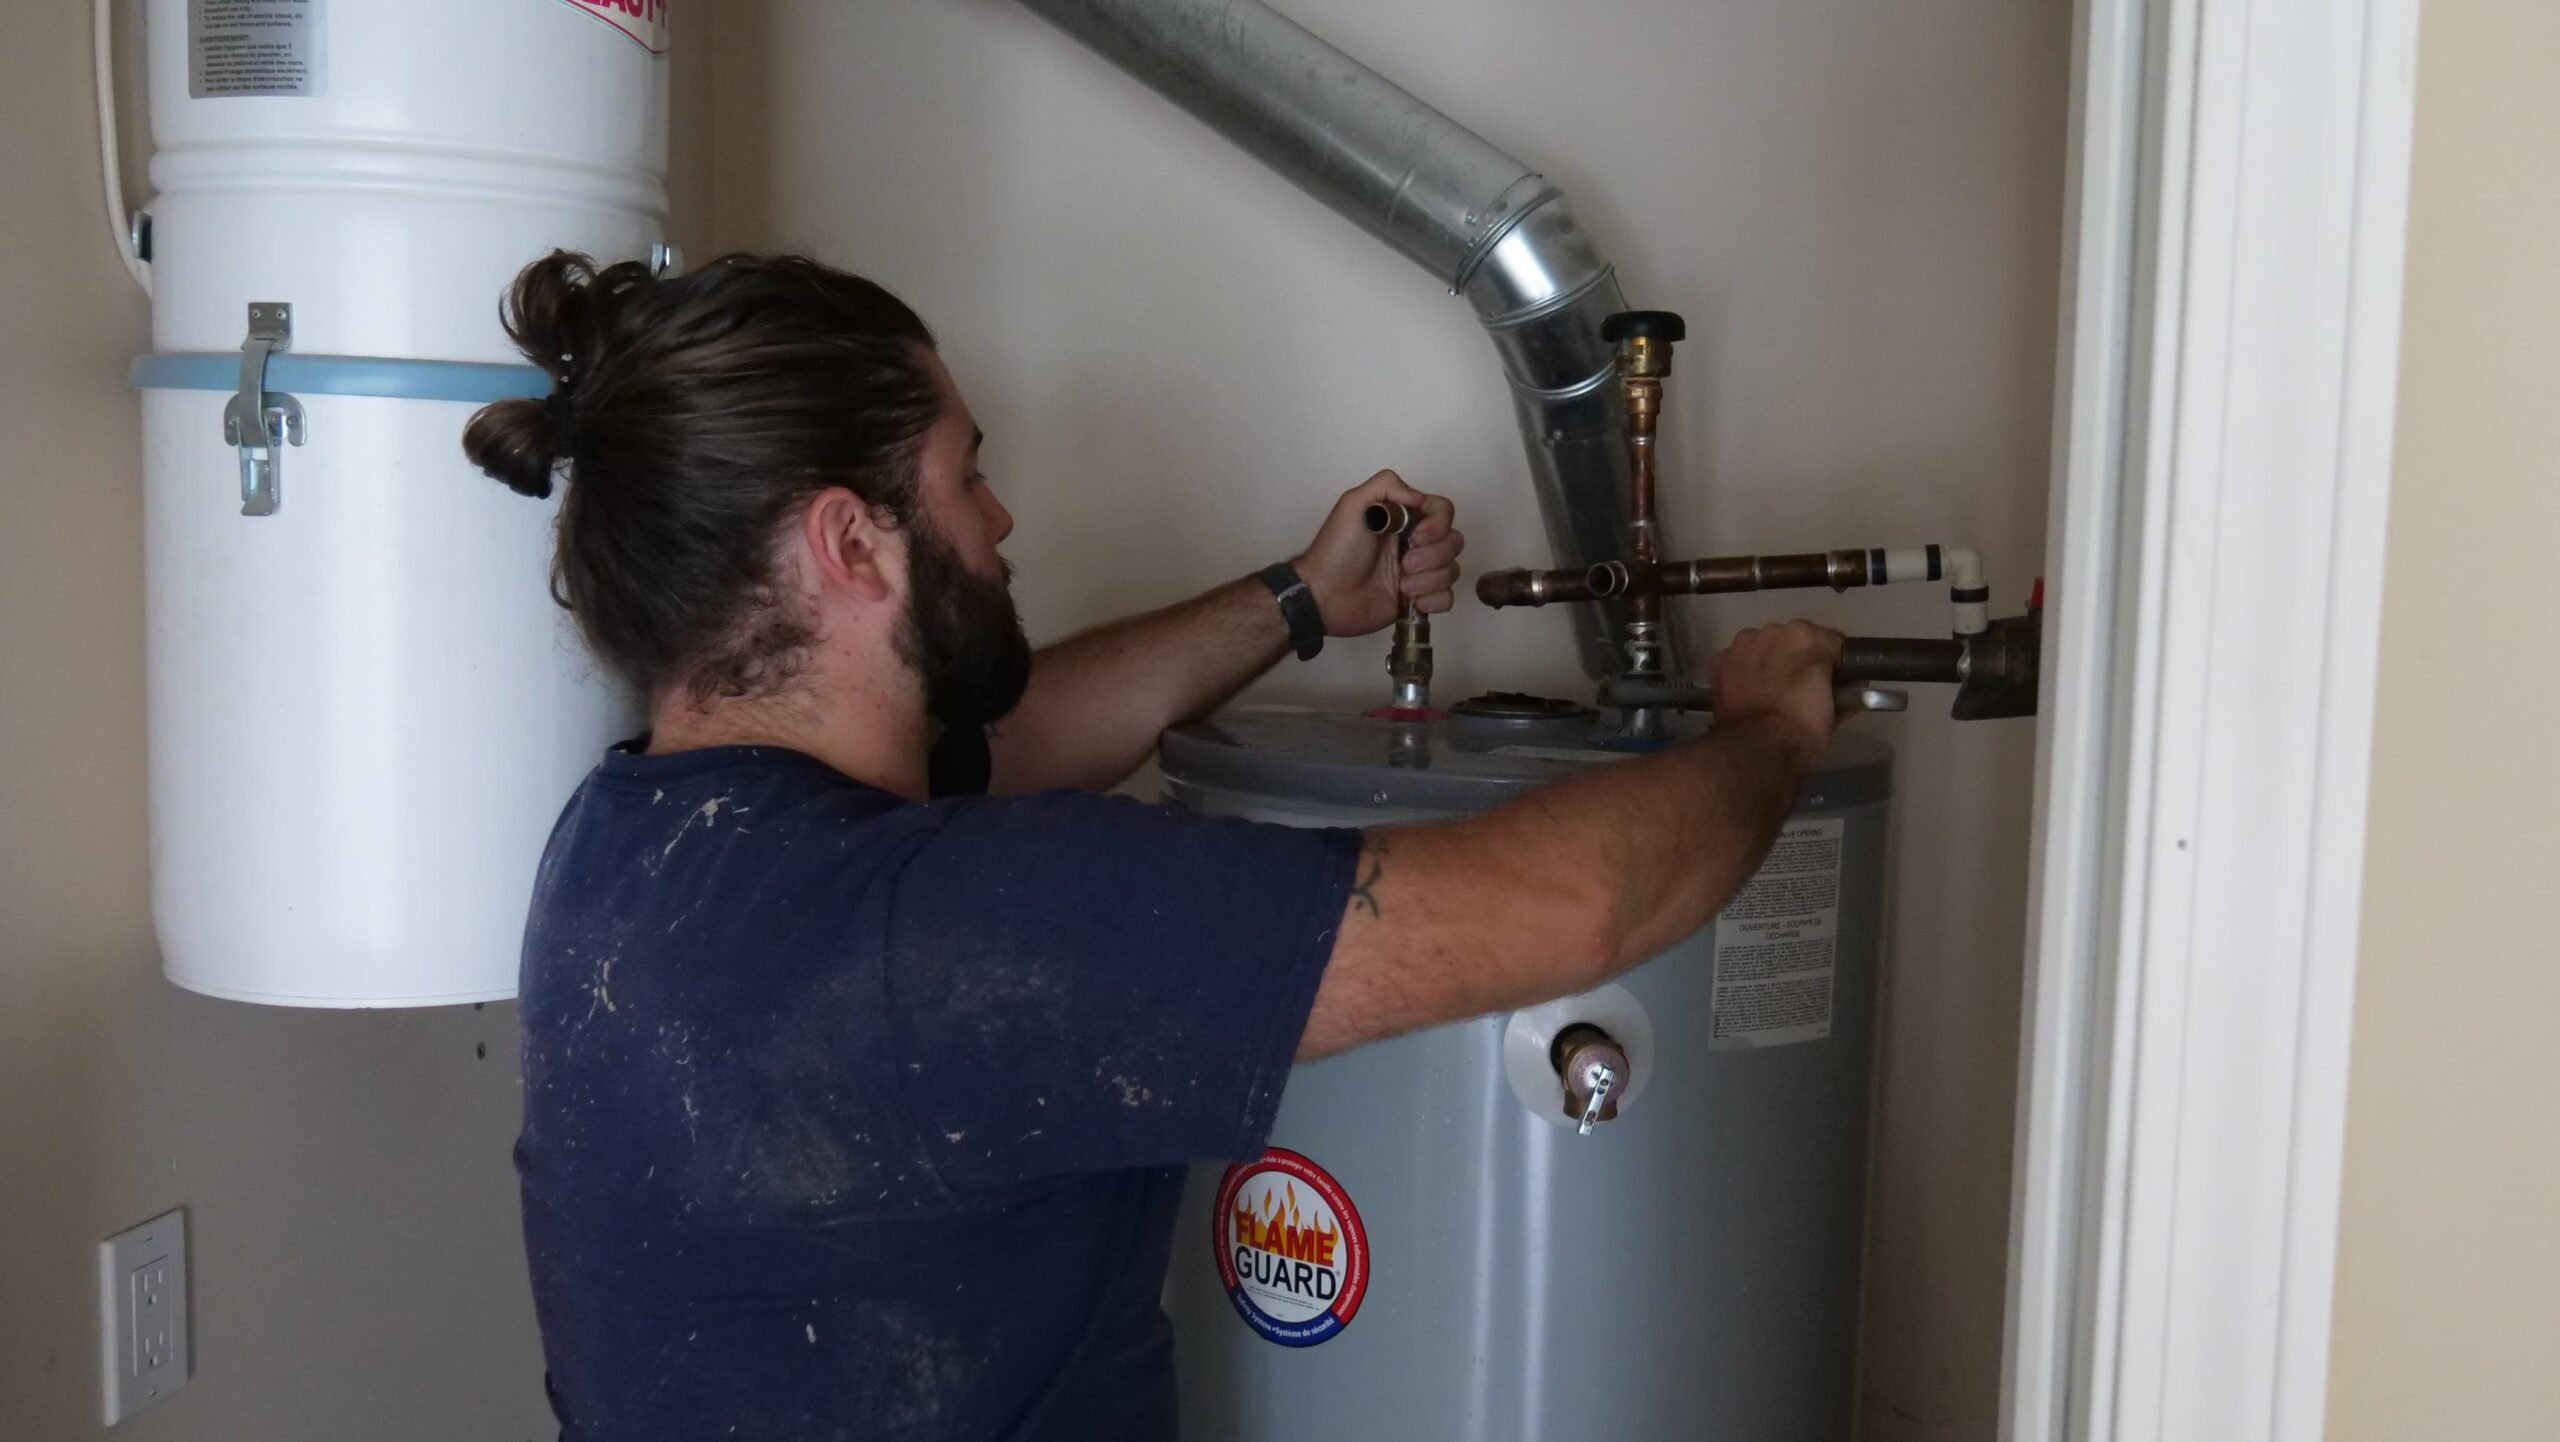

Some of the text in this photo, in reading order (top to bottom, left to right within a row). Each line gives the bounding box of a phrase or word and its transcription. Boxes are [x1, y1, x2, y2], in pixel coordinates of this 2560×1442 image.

[1739, 921, 1781, 932] OUVERTURE
[1331, 1192, 1345, 1211] contre
[1235, 1209, 1334, 1268] FLAME
[1236, 1293, 1252, 1316] Safety
[1251, 1311, 1272, 1331] System
[1302, 1328, 1311, 1337] de
